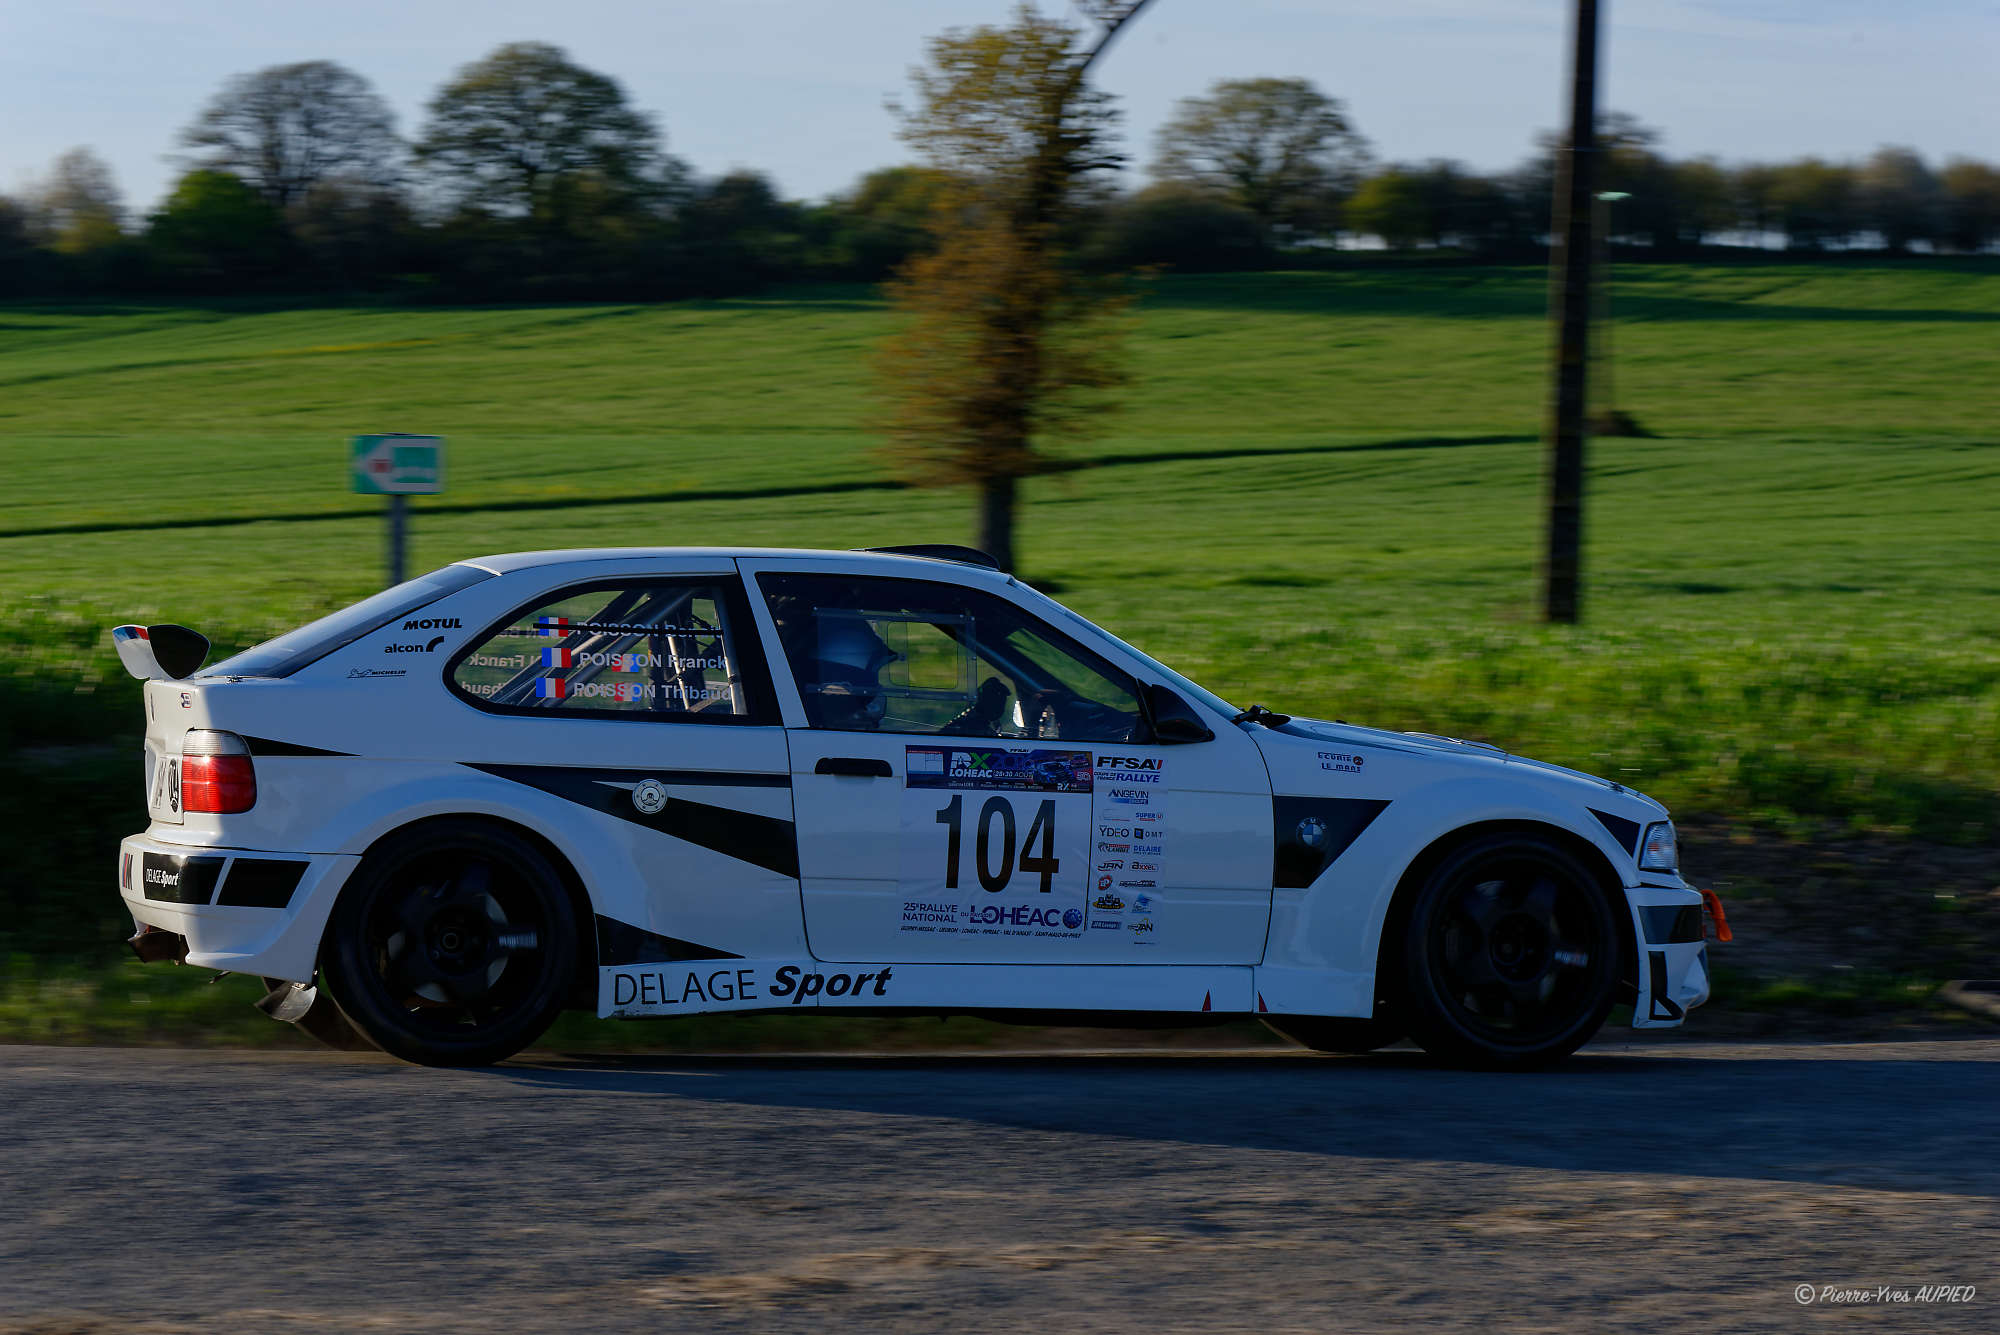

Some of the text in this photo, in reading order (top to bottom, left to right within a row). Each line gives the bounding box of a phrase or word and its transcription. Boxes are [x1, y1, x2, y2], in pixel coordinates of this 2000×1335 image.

[402, 618, 462, 630] MOTUL
[384, 643, 424, 654] alcon
[579, 652, 726, 670] POISSON Franck
[574, 682, 732, 701] POISSON Thibaud
[1096, 756, 1157, 769] FFSA
[1116, 773, 1160, 783] RALLYE
[936, 794, 1060, 894] 104
[145, 868, 180, 887] DELAGE Sport
[919, 903, 957, 913] RALLYE
[970, 904, 1060, 926] LOHÉAC
[902, 912, 957, 922] NATIONAL
[613, 965, 893, 1005] DELAGE Sport
